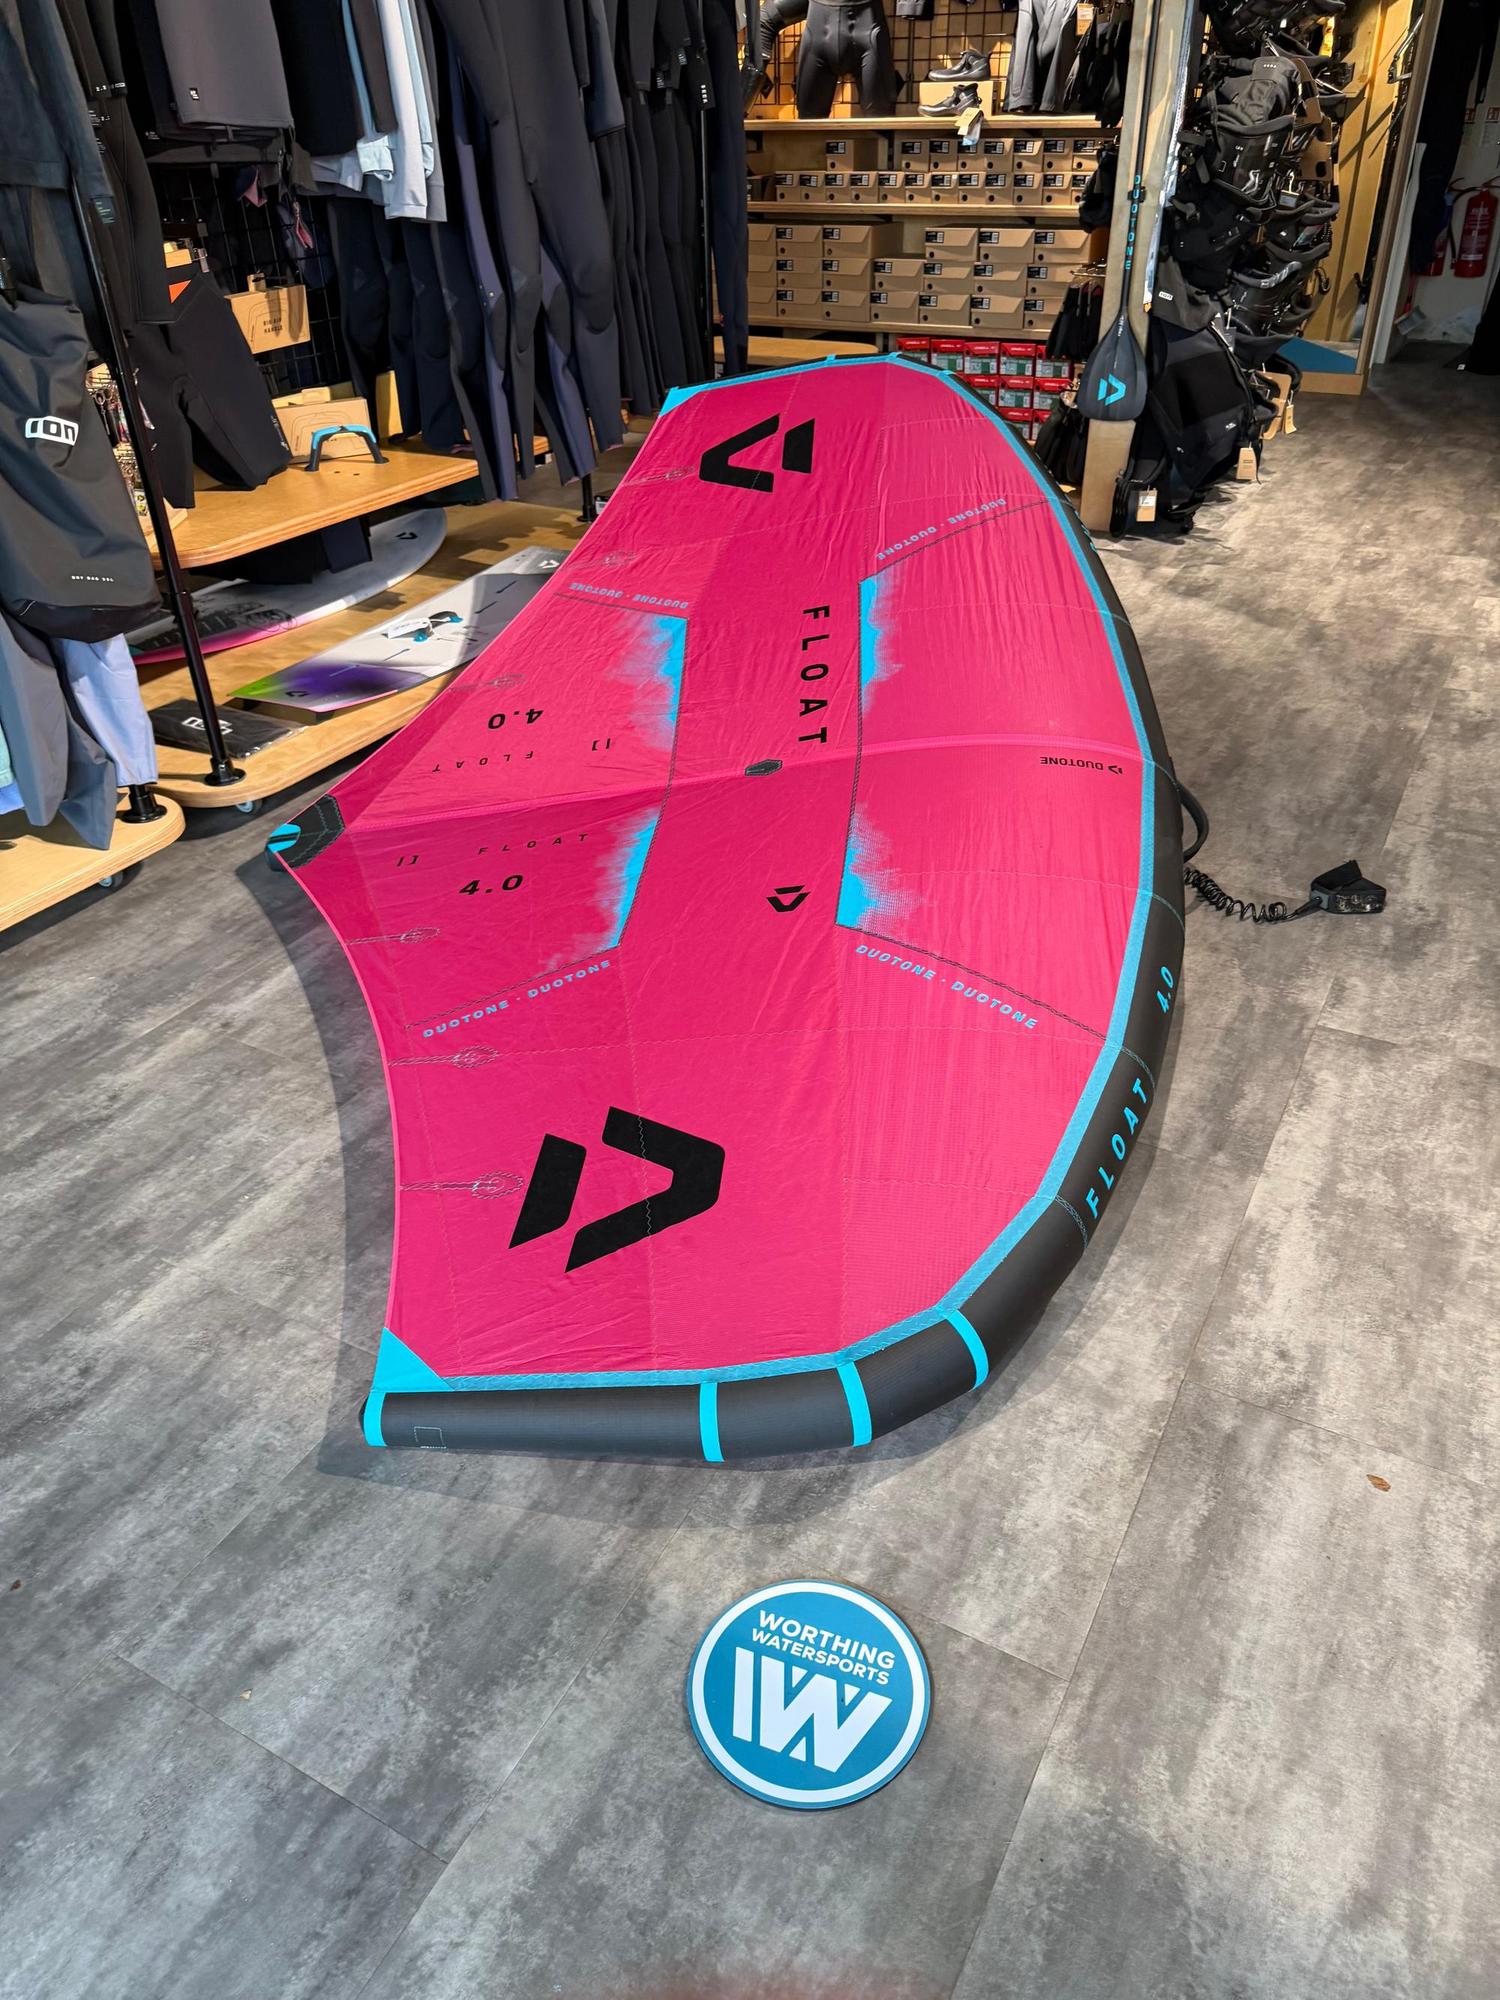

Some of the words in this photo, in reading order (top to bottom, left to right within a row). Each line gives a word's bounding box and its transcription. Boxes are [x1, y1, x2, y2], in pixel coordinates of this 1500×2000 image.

[1124, 174, 1141, 270] DUOTONE
[947, 498, 1006, 525] DUOTONE
[876, 526, 938, 561] DUOTONE
[568, 582, 624, 599] DUOTONE
[631, 593, 690, 609] DUOTONE
[798, 605, 830, 744] FLOAT
[487, 708, 544, 730] 4.0
[431, 750, 534, 773] FLOAT
[1039, 756, 1104, 771] DUOTONE
[478, 833, 588, 855] FLOAT
[458, 874, 524, 895] 4.0
[422, 1000, 510, 1038] DUOTONE
[526, 959, 620, 999] DUOTONE
[855, 944, 937, 981] DUOTONE
[951, 981, 1039, 1029] DUOTONE
[1156, 966, 1174, 1014] 4.0
[1085, 1077, 1148, 1219] FLOAT
[752, 1627, 890, 1685] WATERSPORTS
[759, 1609, 896, 1670] WORTHING
